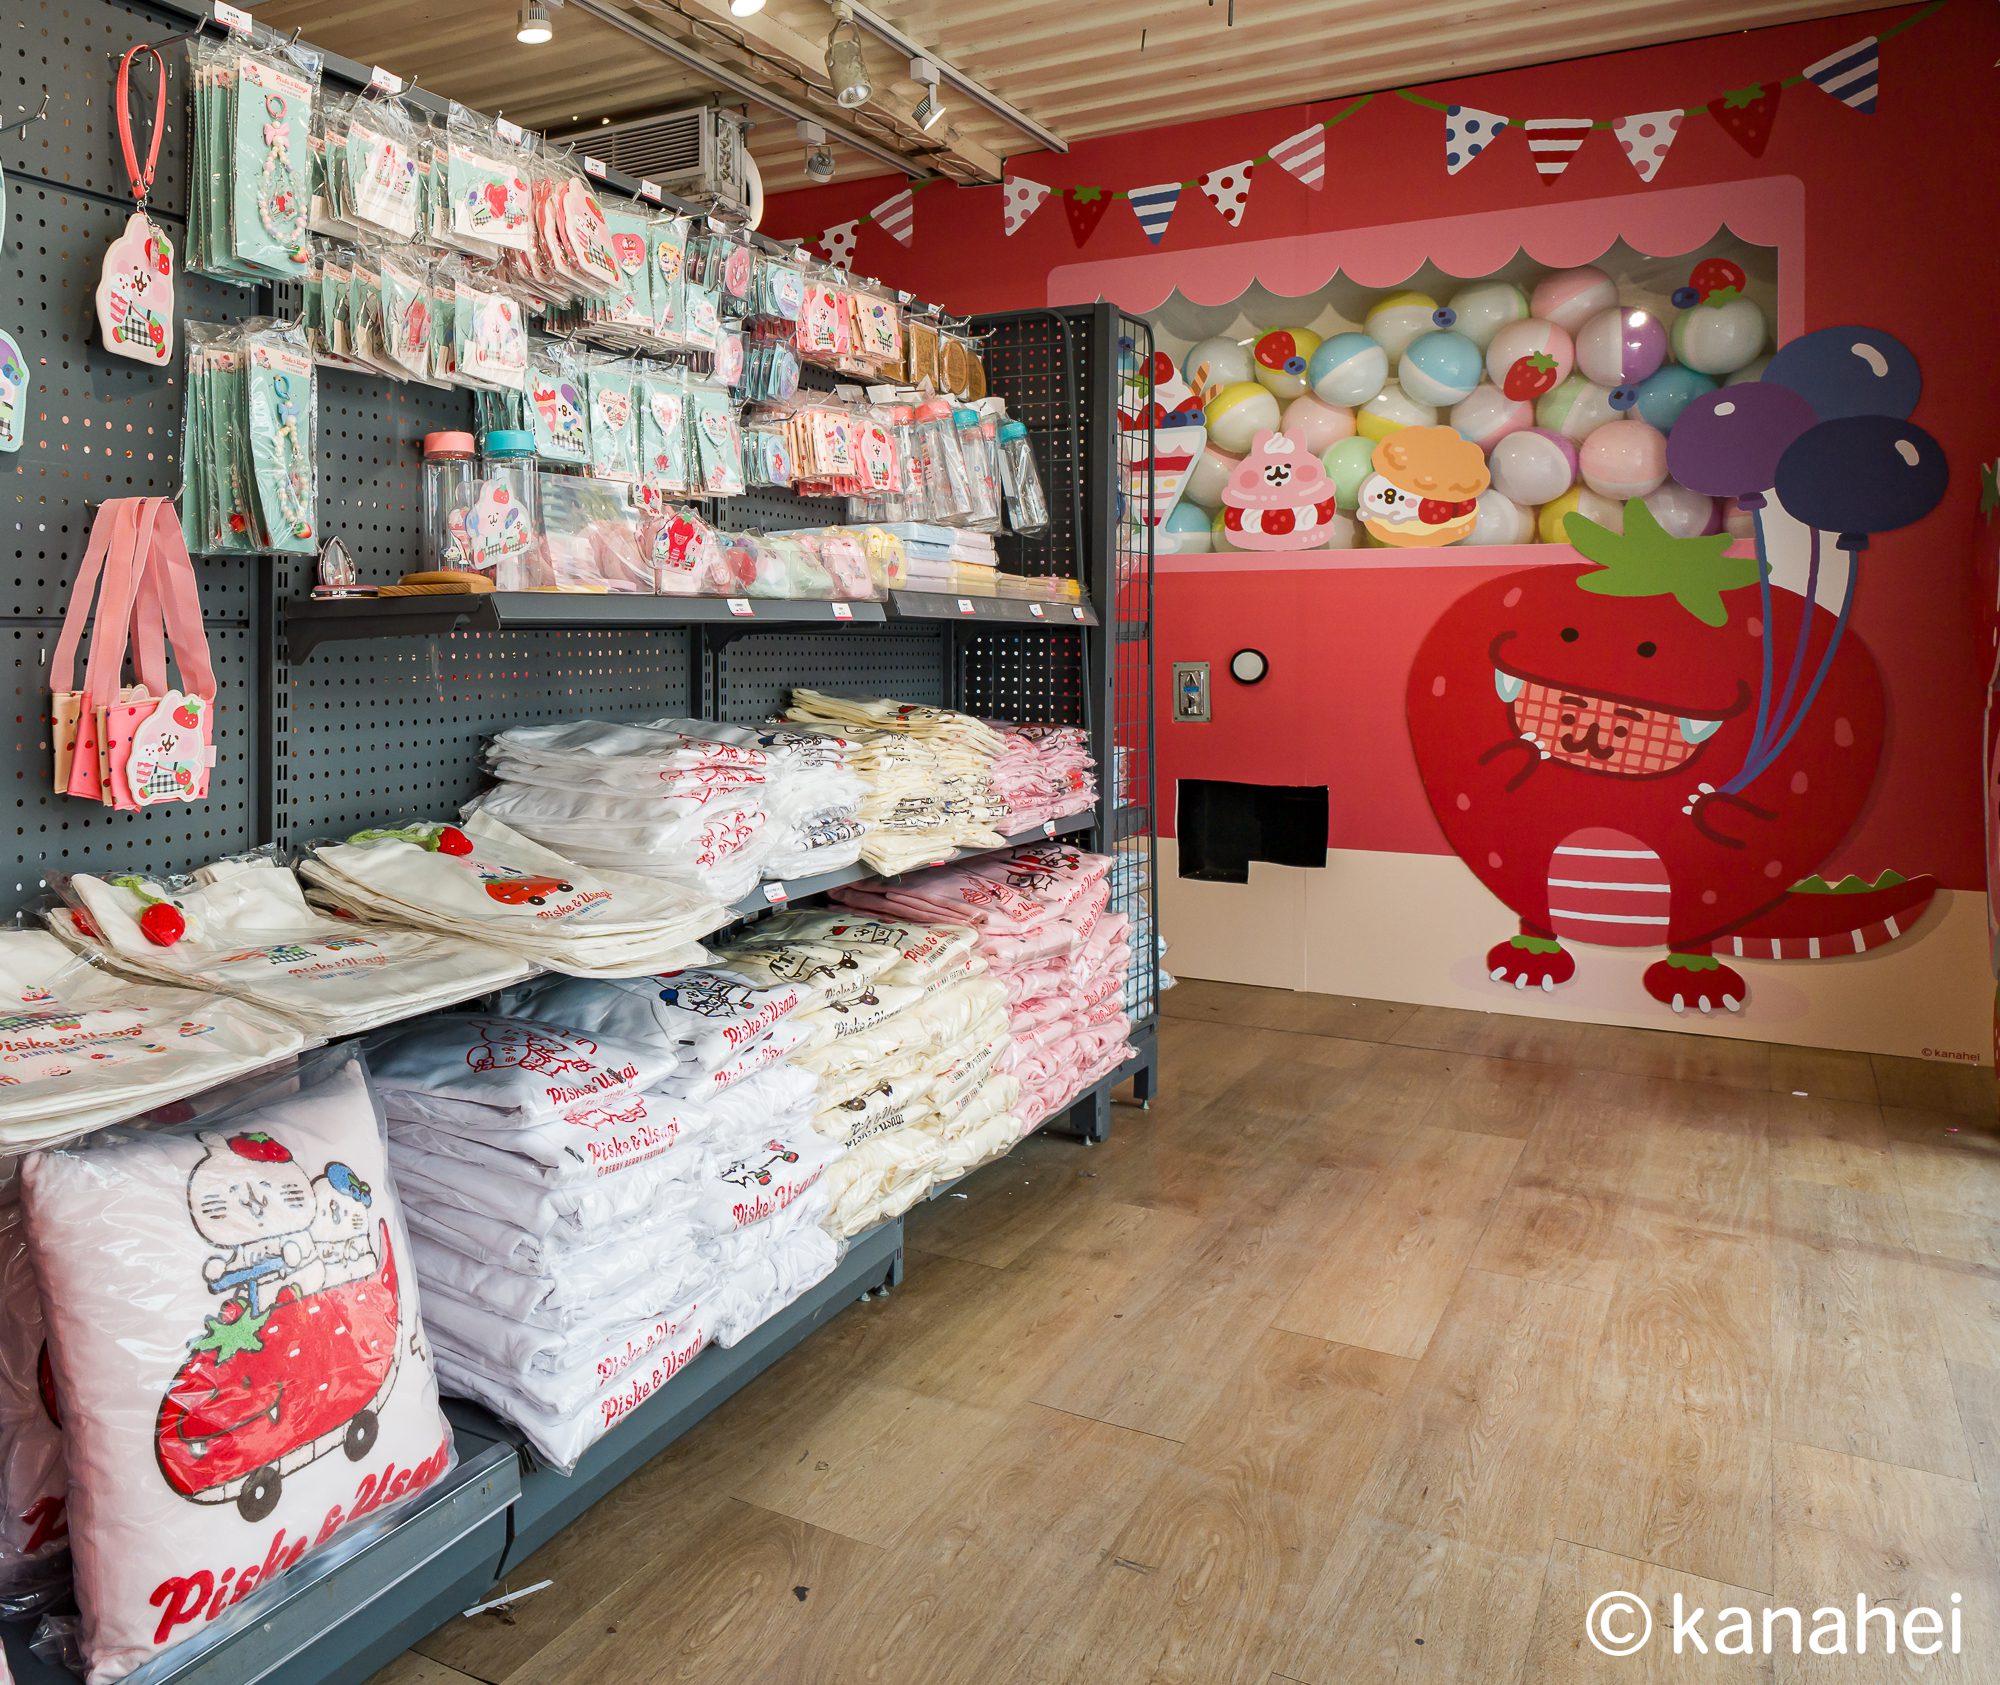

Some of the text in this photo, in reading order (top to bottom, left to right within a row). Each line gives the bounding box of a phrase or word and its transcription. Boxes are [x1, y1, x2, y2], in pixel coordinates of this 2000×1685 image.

[572, 900, 581, 908] &
[0, 1037, 59, 1052] iske
[59, 1037, 76, 1046] &
[723, 1018, 761, 1050] Piske
[759, 1009, 770, 1028] &
[1934, 1049, 1981, 1062] kanahei
[587, 1136, 632, 1165] Piske
[630, 1135, 641, 1151] &
[604, 1163, 624, 1175] BERRY
[624, 1156, 643, 1169] BERRY
[732, 1194, 769, 1232] Piske
[601, 1379, 652, 1428] Piske
[652, 1369, 663, 1389] &
[149, 1528, 308, 1645] Piske
[313, 1504, 345, 1547] &
